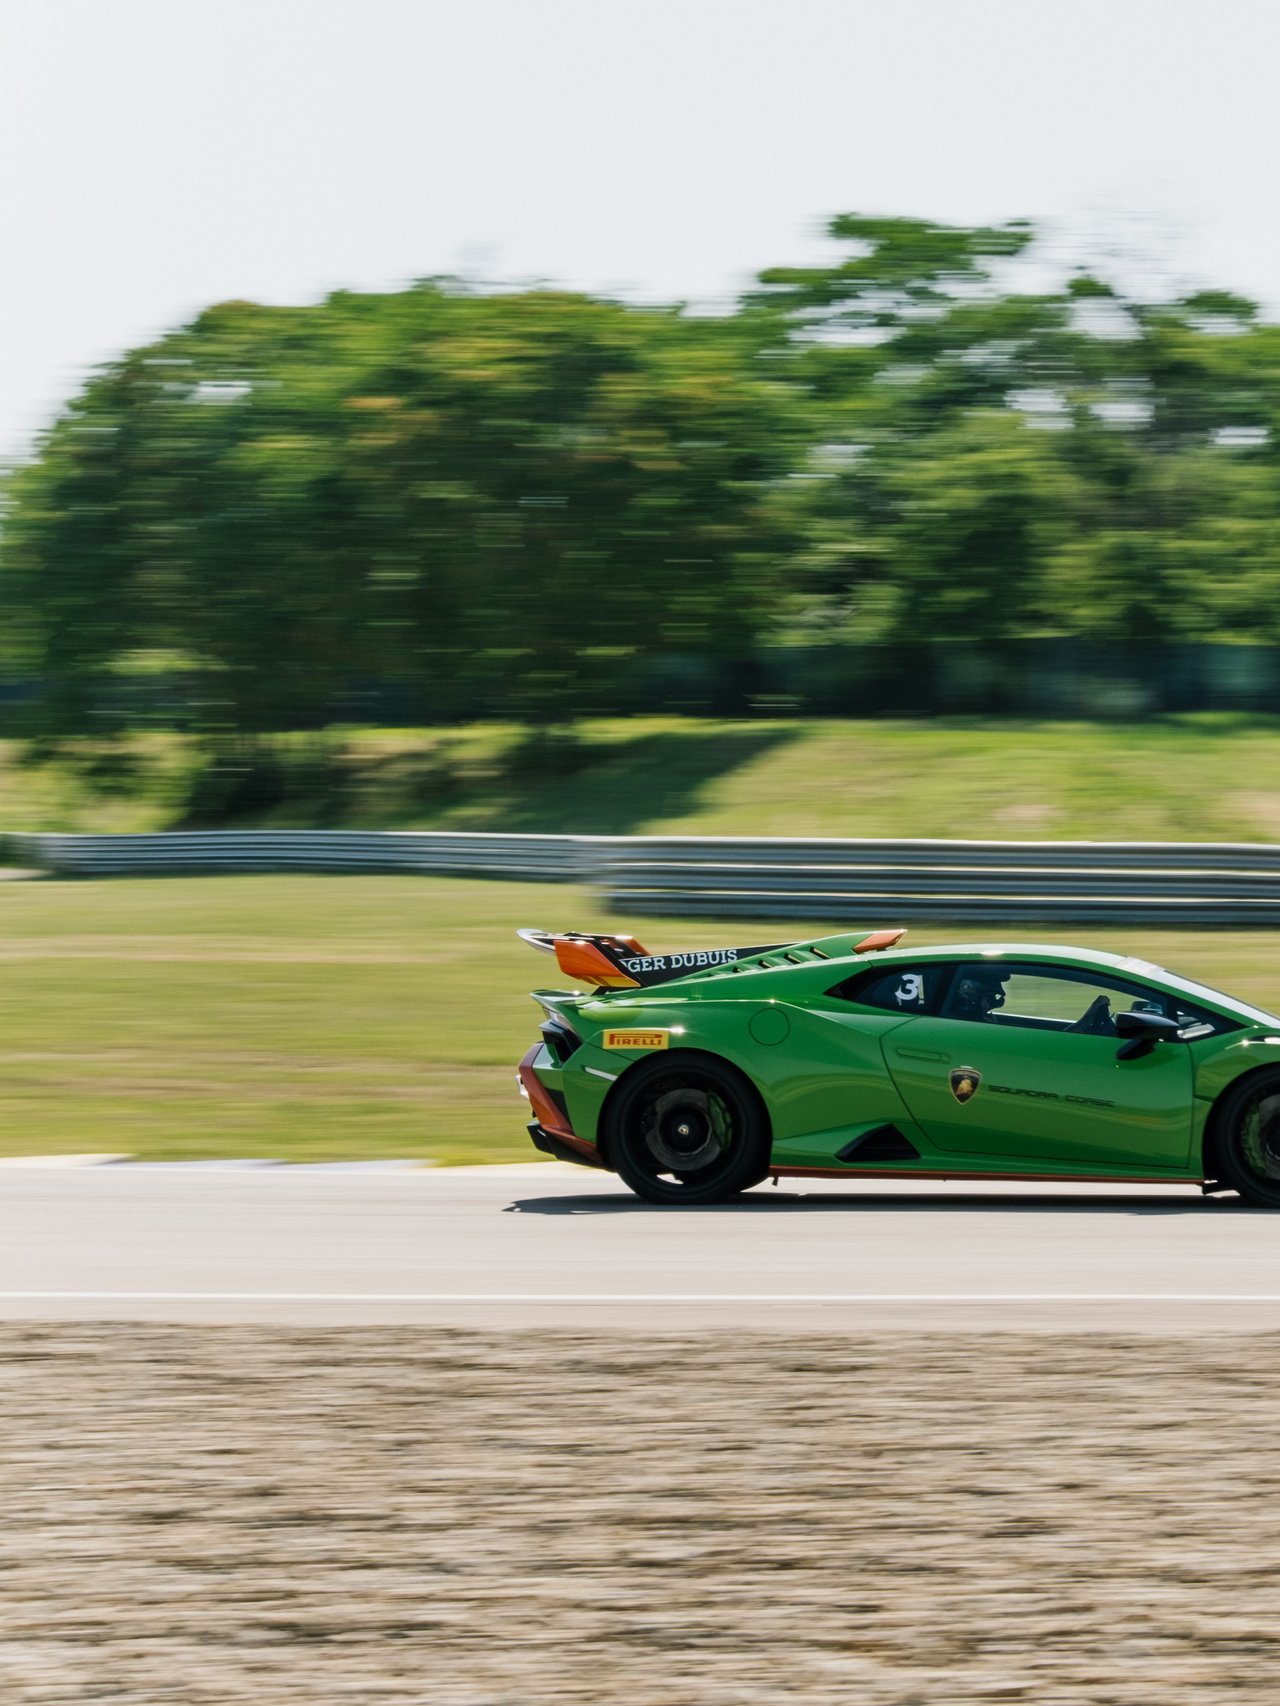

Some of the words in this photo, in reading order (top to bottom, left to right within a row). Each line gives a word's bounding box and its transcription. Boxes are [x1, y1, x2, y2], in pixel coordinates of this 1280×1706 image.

[670, 949, 738, 969] DUBUIS
[894, 973, 920, 1001] 3
[608, 1033, 663, 1046] PIRELLI
